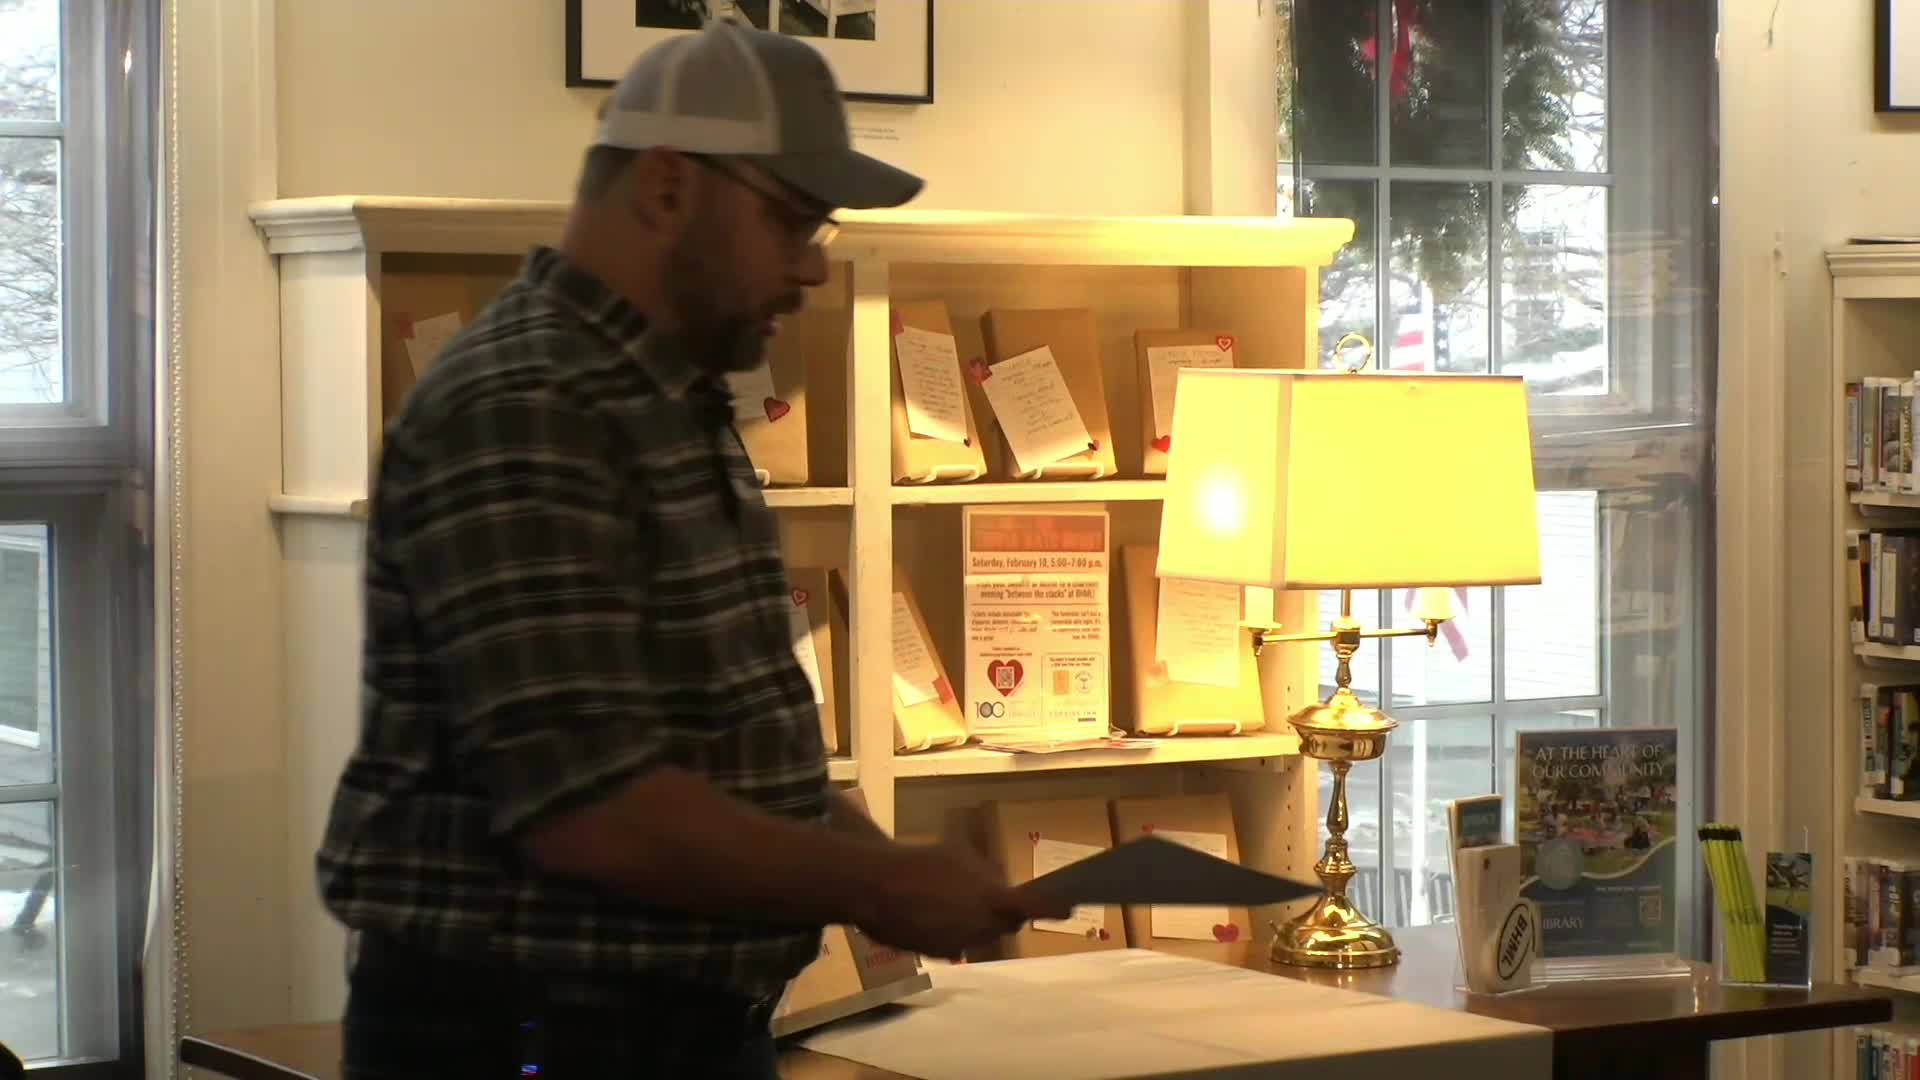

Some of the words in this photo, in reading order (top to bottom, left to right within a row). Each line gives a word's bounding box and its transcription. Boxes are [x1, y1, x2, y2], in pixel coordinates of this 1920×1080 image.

[972, 556, 1004, 569] Saturday,
[1006, 556, 1037, 568] February
[1535, 746, 1556, 761] AT
[1560, 745, 1589, 760] THE
[1591, 744, 1636, 760] HEART
[1642, 743, 1665, 759] OF
[1532, 763, 1565, 778] OUR
[1542, 917, 1584, 929] IBRARY
[1500, 913, 1528, 967] BHML
